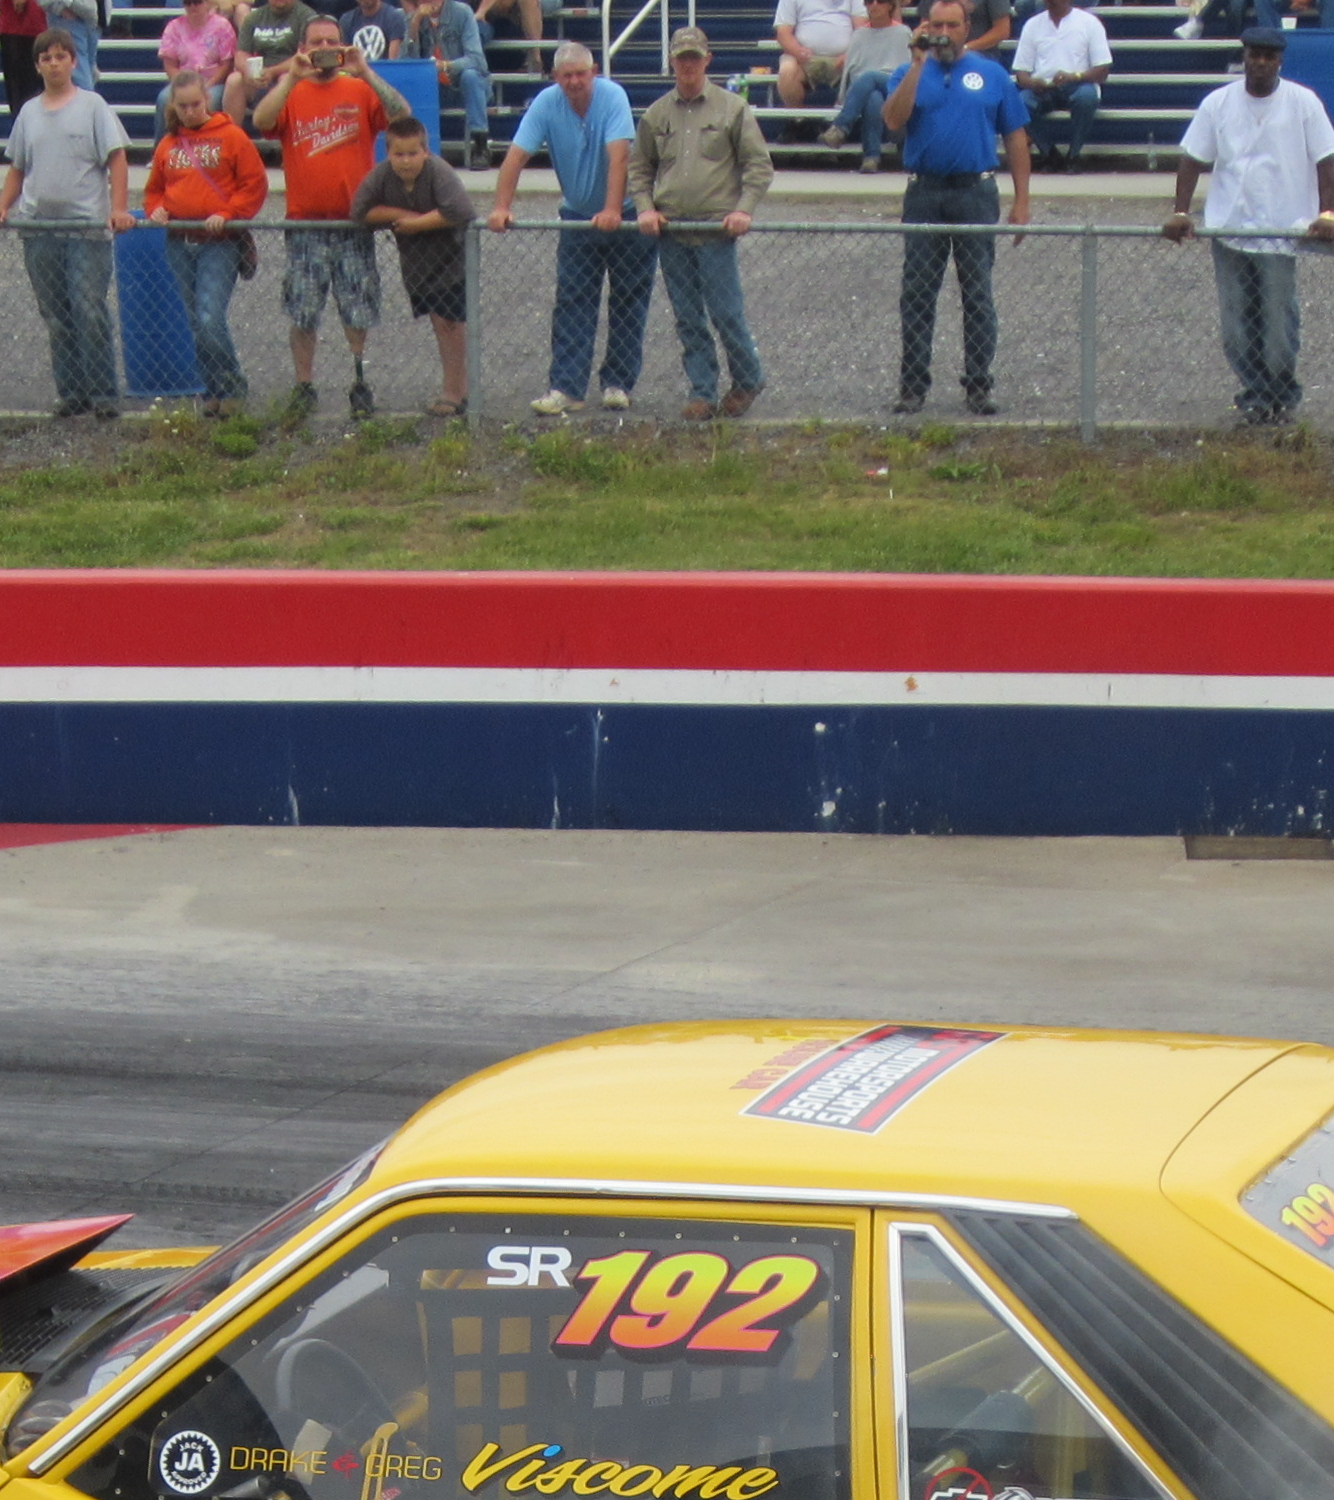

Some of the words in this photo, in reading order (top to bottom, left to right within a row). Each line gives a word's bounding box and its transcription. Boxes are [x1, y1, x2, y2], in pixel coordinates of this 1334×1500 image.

[775, 1051, 893, 1119] WAREHOUSE
[486, 1245, 572, 1287] SR
[553, 1249, 825, 1357] 192
[174, 1451, 205, 1472] JA
[179, 1441, 204, 1453] JACK
[170, 1470, 207, 1486] APPROVED
[229, 1446, 328, 1475] DRAKE
[365, 1453, 443, 1481] GREG
[461, 1442, 779, 1500] Viscome
